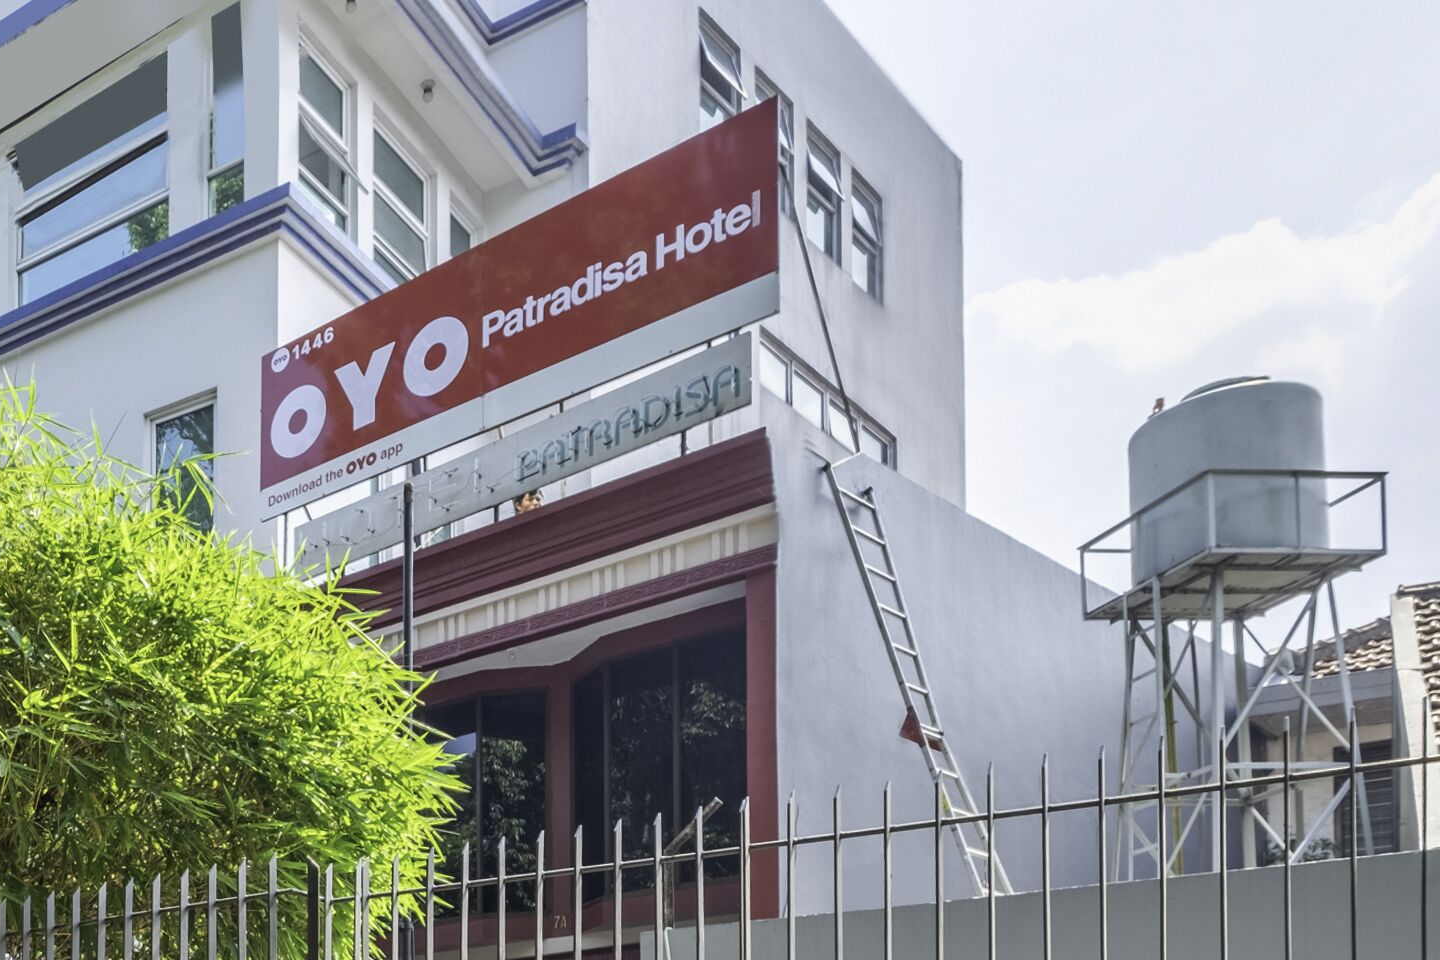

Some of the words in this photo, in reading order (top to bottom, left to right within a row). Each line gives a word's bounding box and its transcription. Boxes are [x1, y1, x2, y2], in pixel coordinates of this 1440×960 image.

[270, 315, 469, 458] OYO
[481, 250, 648, 349] Patradisa
[655, 189, 761, 270] Hotel
[291, 326, 335, 360] 1446
[516, 364, 742, 484] PATRADISA
[267, 474, 323, 508] Download
[325, 468, 343, 484] the
[346, 452, 377, 475] OYO
[380, 442, 404, 460] app
[553, 915, 568, 929] 7A
